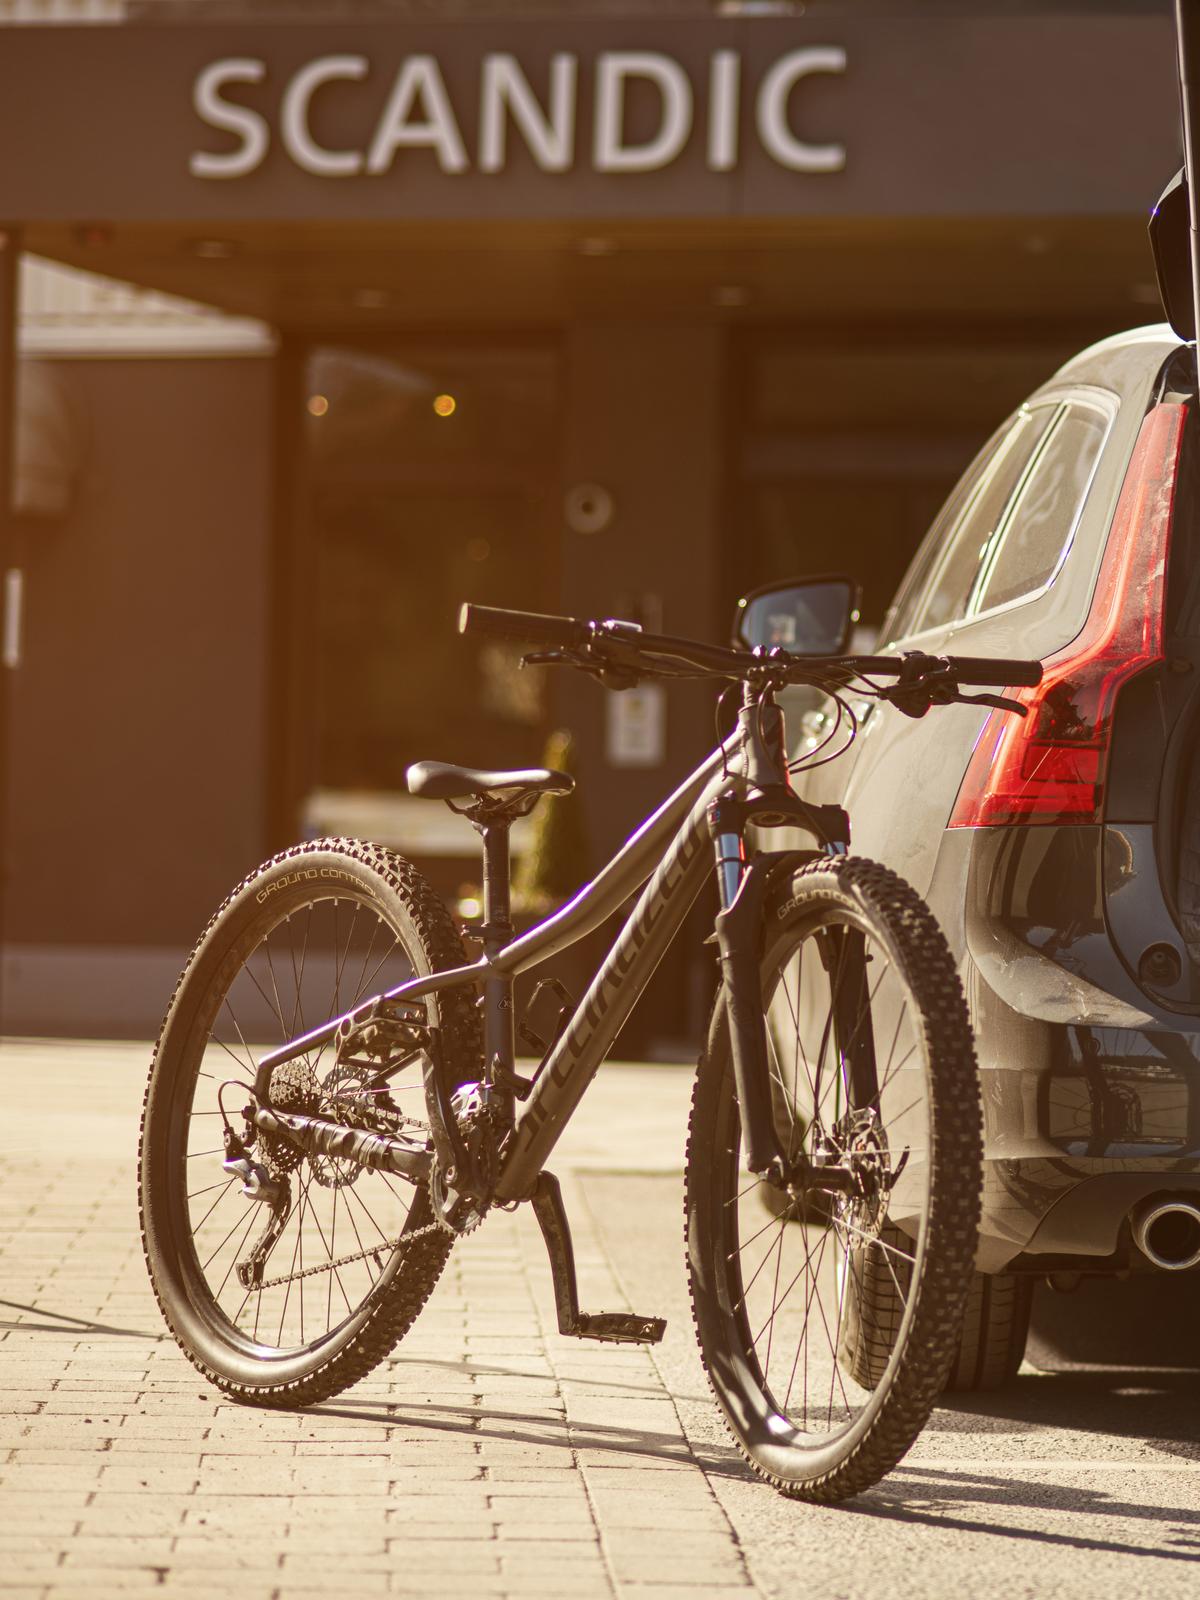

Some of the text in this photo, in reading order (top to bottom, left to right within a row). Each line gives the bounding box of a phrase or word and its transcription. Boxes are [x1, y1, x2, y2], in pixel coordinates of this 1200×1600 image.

[190, 46, 846, 178] SCANDIC
[256, 869, 317, 903] GROUND
[777, 888, 832, 919] GROUND
